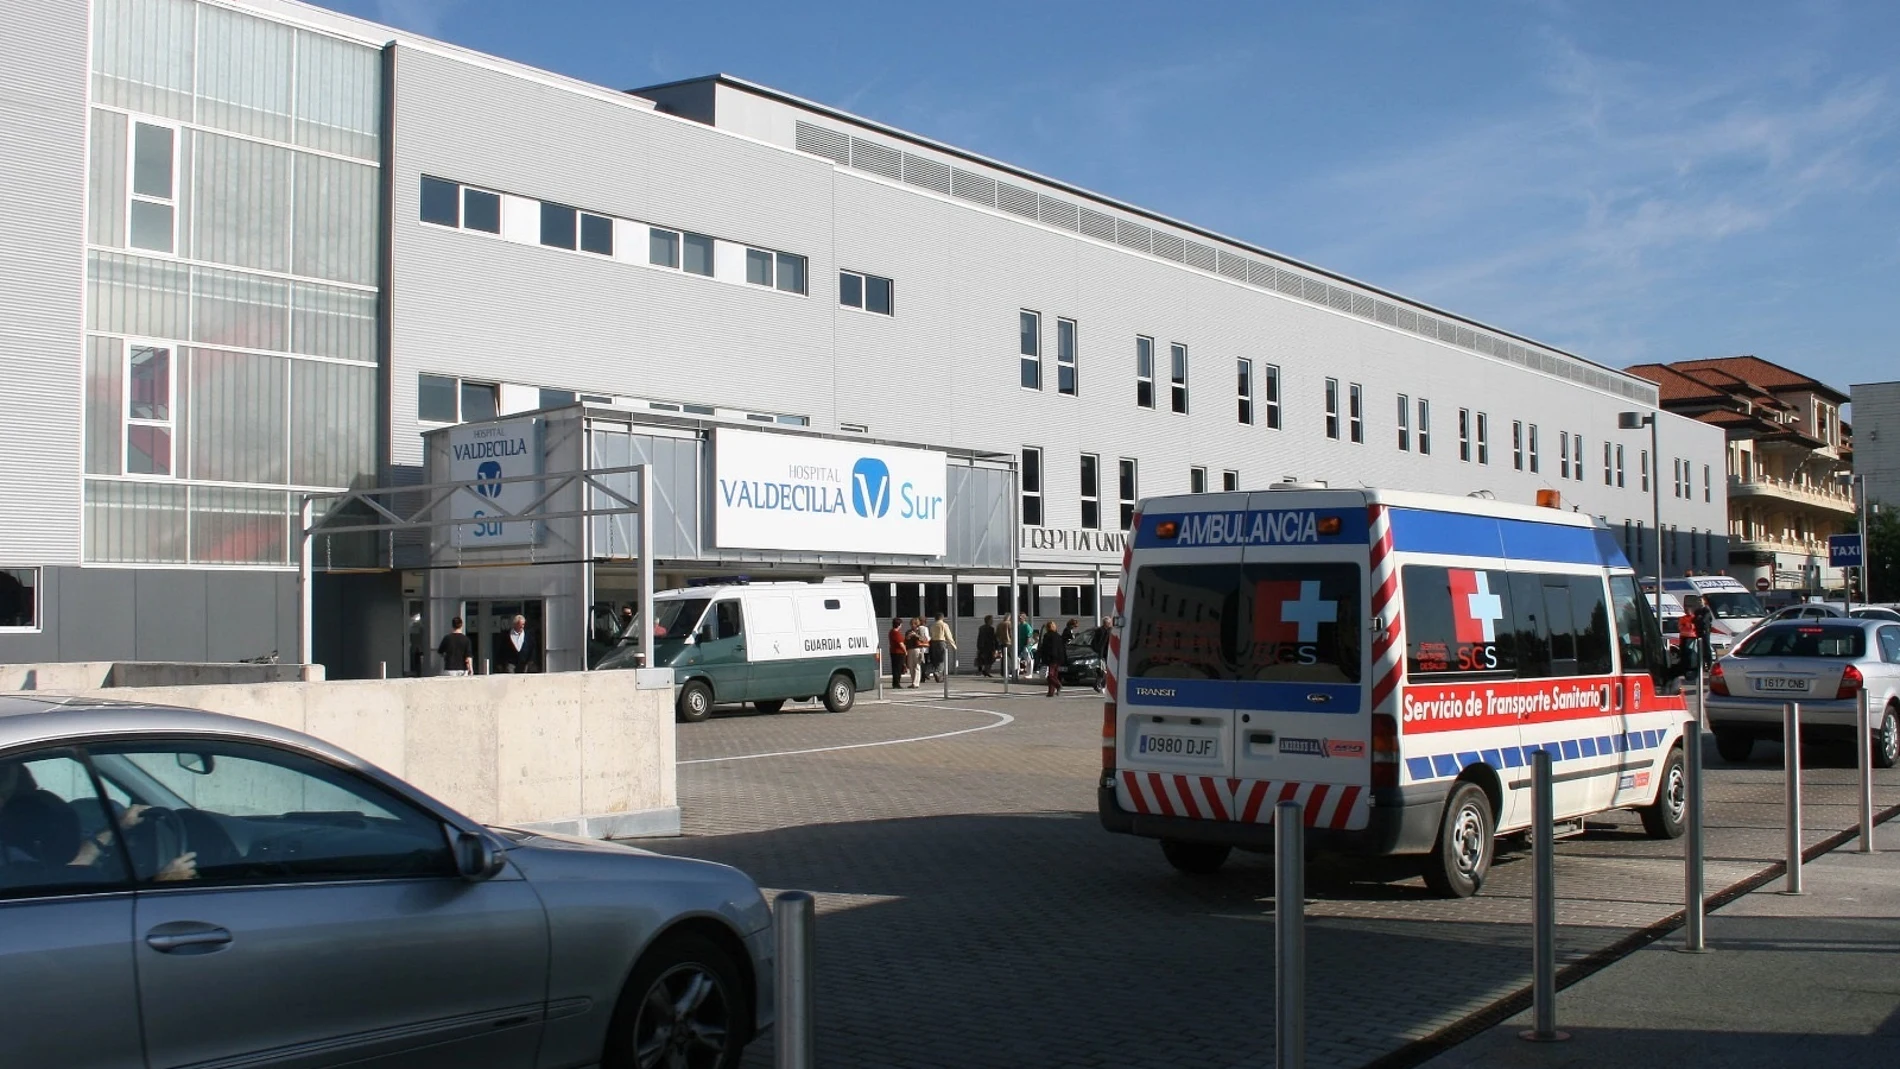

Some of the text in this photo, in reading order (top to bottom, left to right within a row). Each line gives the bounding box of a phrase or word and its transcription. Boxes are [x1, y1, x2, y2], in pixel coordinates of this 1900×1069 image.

[473, 427, 506, 438] HOSPITAL
[453, 438, 527, 461] VALDECILLA
[788, 464, 841, 483] HOSPITAL
[719, 479, 847, 514] VALDECILLA
[901, 482, 943, 519] Sur
[473, 510, 504, 537] Sur
[1177, 511, 1319, 545] AMBULANCIA
[1830, 545, 1861, 557] TAXI
[804, 636, 869, 652] GUARDIA CIVIL
[1457, 646, 1497, 670] SCS
[1135, 687, 1177, 697] TRANSIT
[1764, 678, 1805, 689] 1617 CNB
[1403, 684, 1600, 722] Servicio de Transporte Sanitario
[1148, 737, 1214, 755] 0980 DJF
